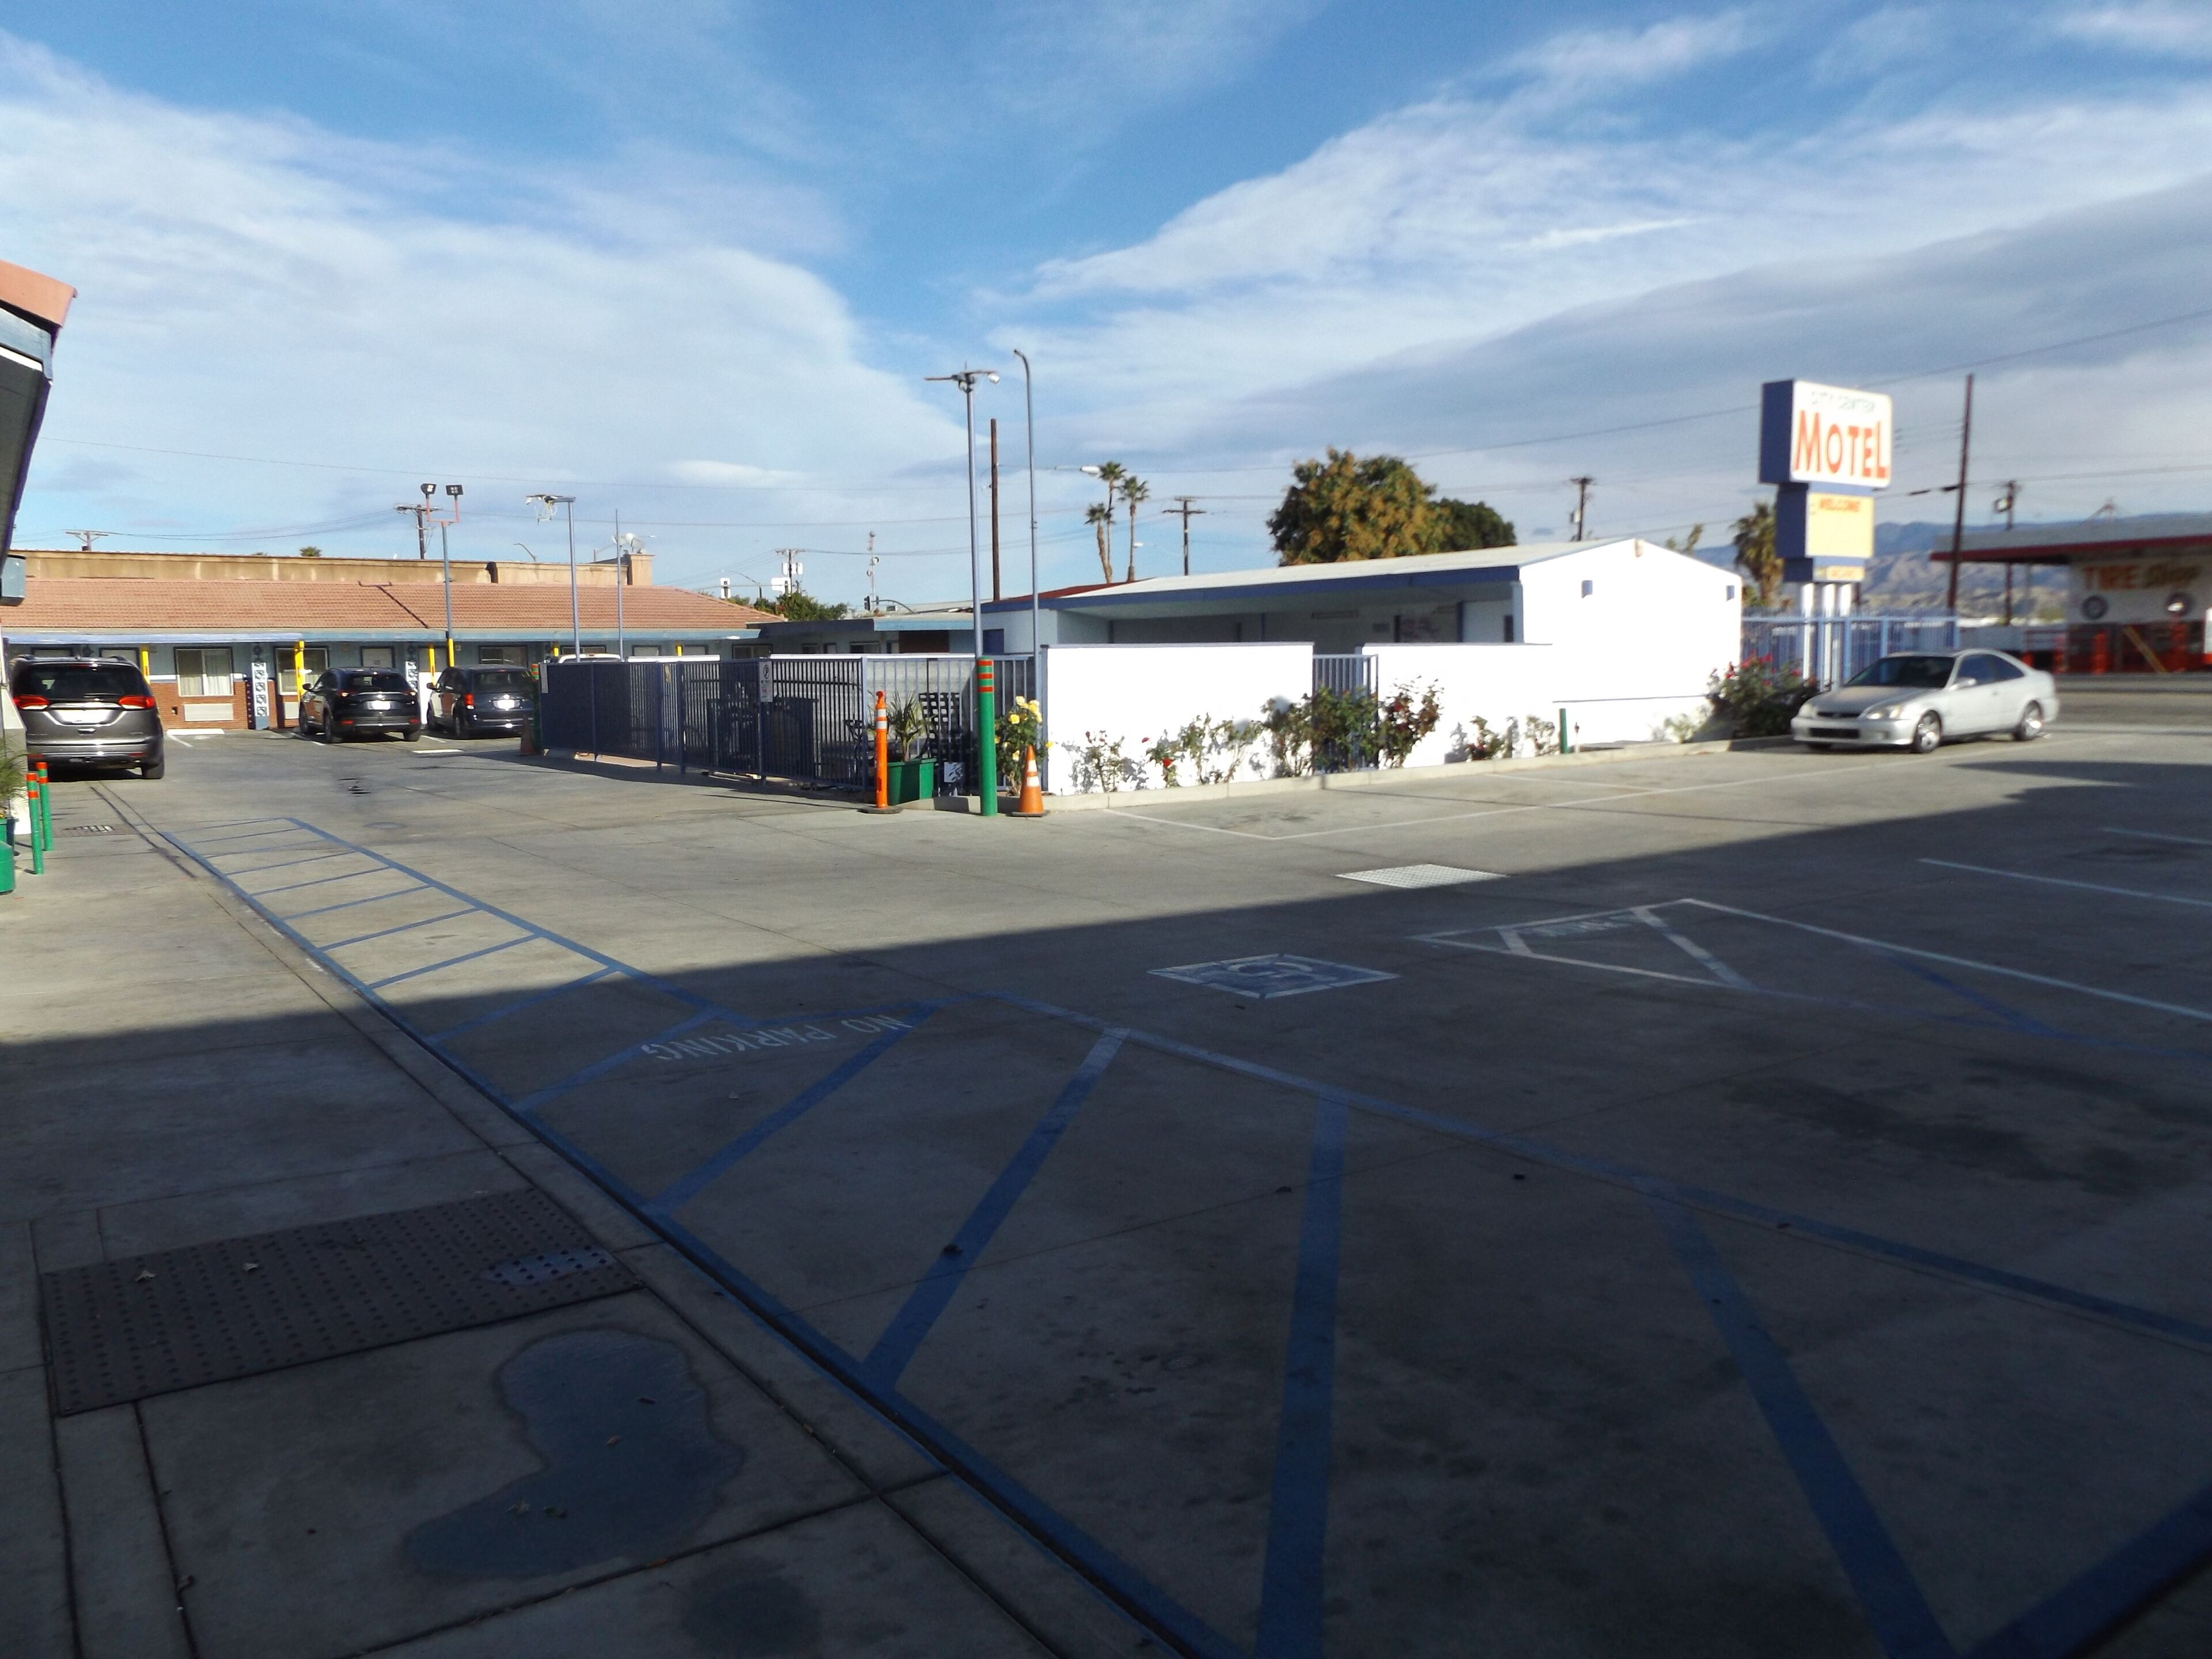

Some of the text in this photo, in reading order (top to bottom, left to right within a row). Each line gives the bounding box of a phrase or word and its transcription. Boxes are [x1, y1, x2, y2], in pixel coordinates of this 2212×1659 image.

[1793, 410, 1887, 479] MOTEL
[641, 1014, 912, 1060] NO PARKING
